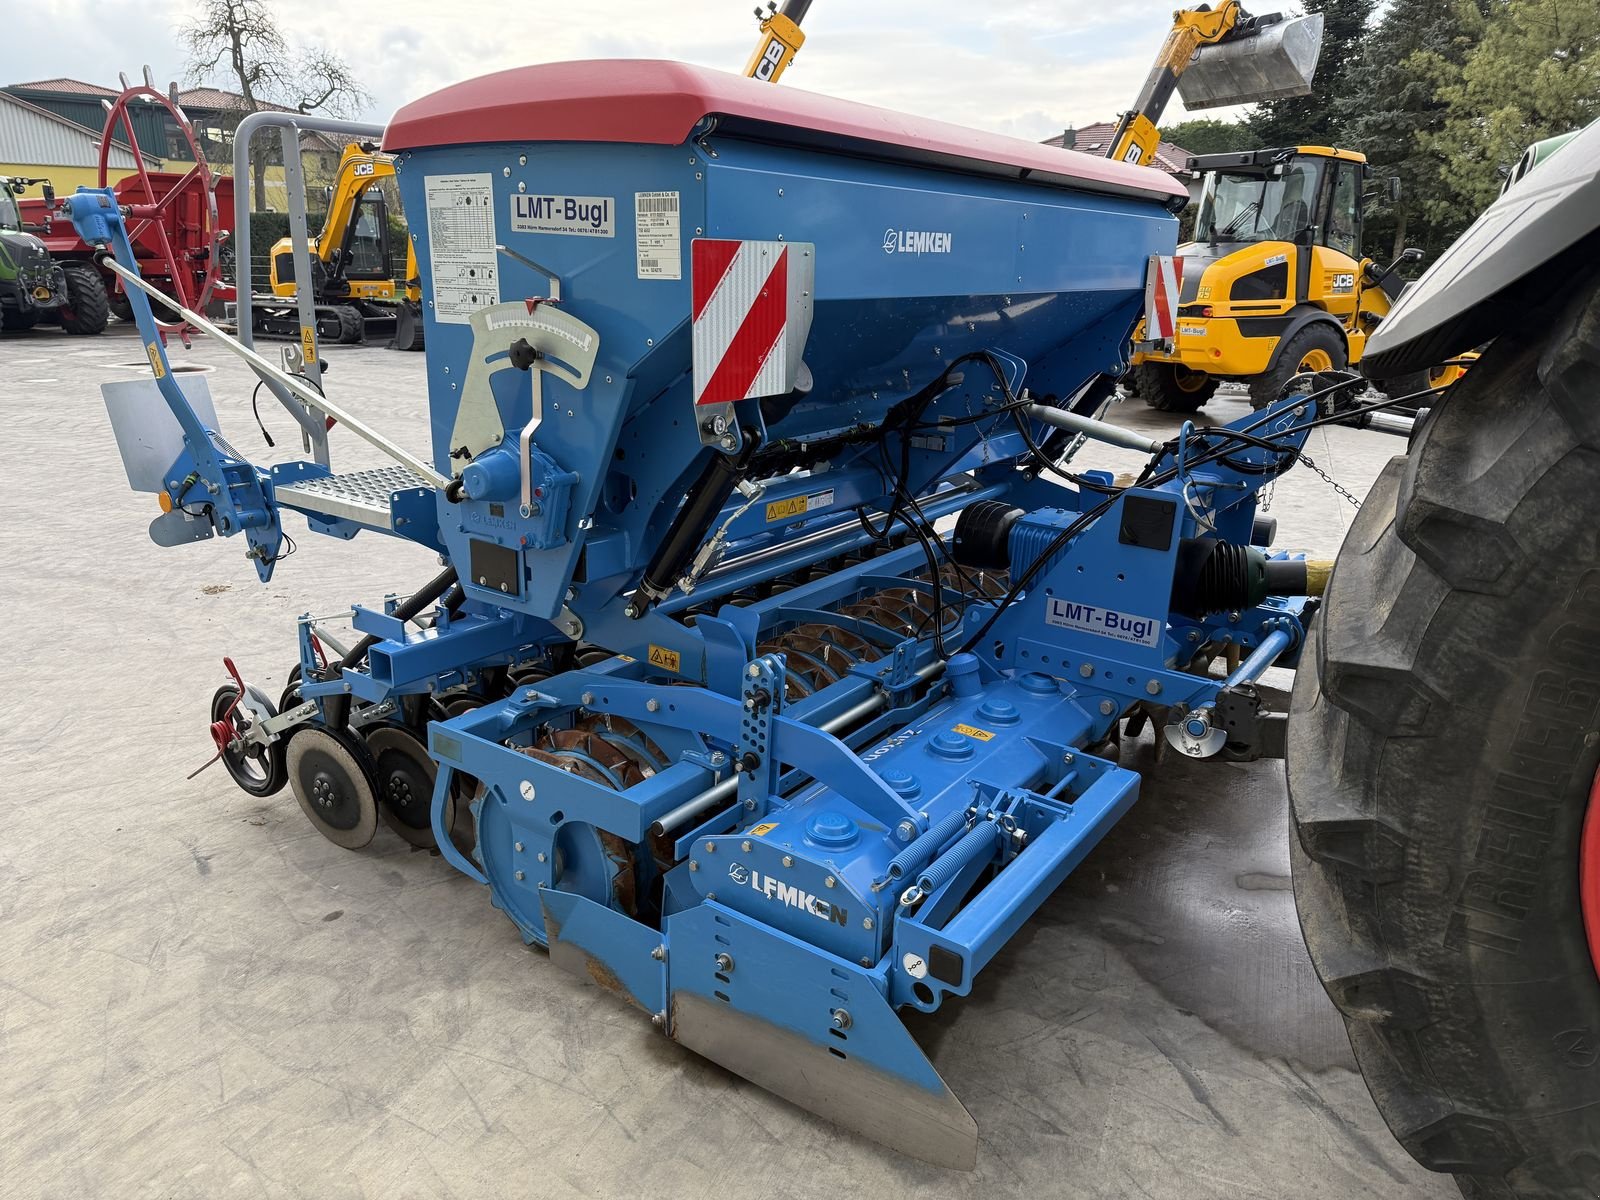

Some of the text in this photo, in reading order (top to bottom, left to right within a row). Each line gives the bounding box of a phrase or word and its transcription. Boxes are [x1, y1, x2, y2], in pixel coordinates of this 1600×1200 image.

[754, 39, 786, 81] CB
[354, 163, 374, 176] JCB
[516, 196, 608, 228] LMT-Bugl
[898, 231, 952, 258] LEMKEN
[1333, 274, 1354, 287] JCB
[1052, 600, 1153, 639] LMT-Bugl
[752, 870, 848, 927] LEMKEN
